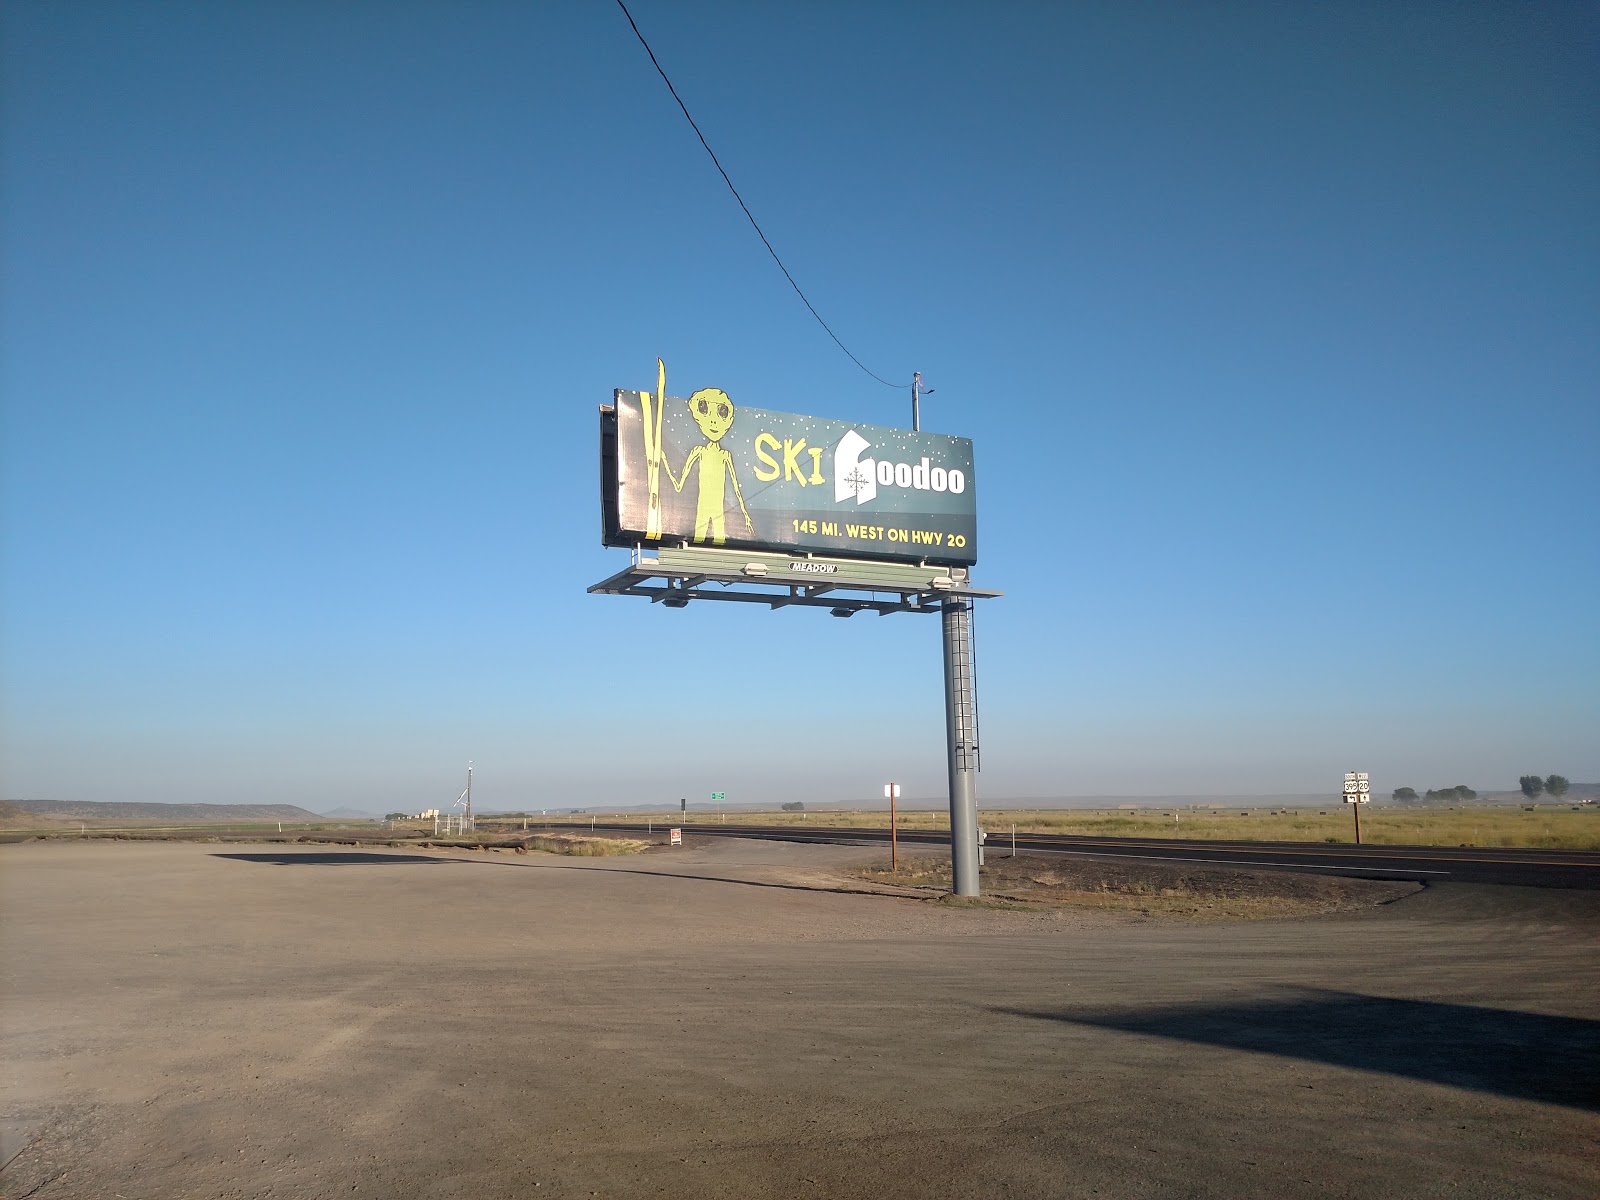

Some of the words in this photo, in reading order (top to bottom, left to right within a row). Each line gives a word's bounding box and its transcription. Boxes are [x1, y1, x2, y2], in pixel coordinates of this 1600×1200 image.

[753, 432, 826, 487] SKI
[792, 519, 818, 534] 145
[821, 521, 843, 537] MI.
[845, 523, 884, 540] WEST
[887, 528, 909, 543] ON
[911, 530, 943, 547] HWY
[947, 534, 966, 548] 20
[792, 562, 836, 573] MEADOW
[1345, 782, 1358, 791] 395
[1359, 782, 1368, 790] 20
